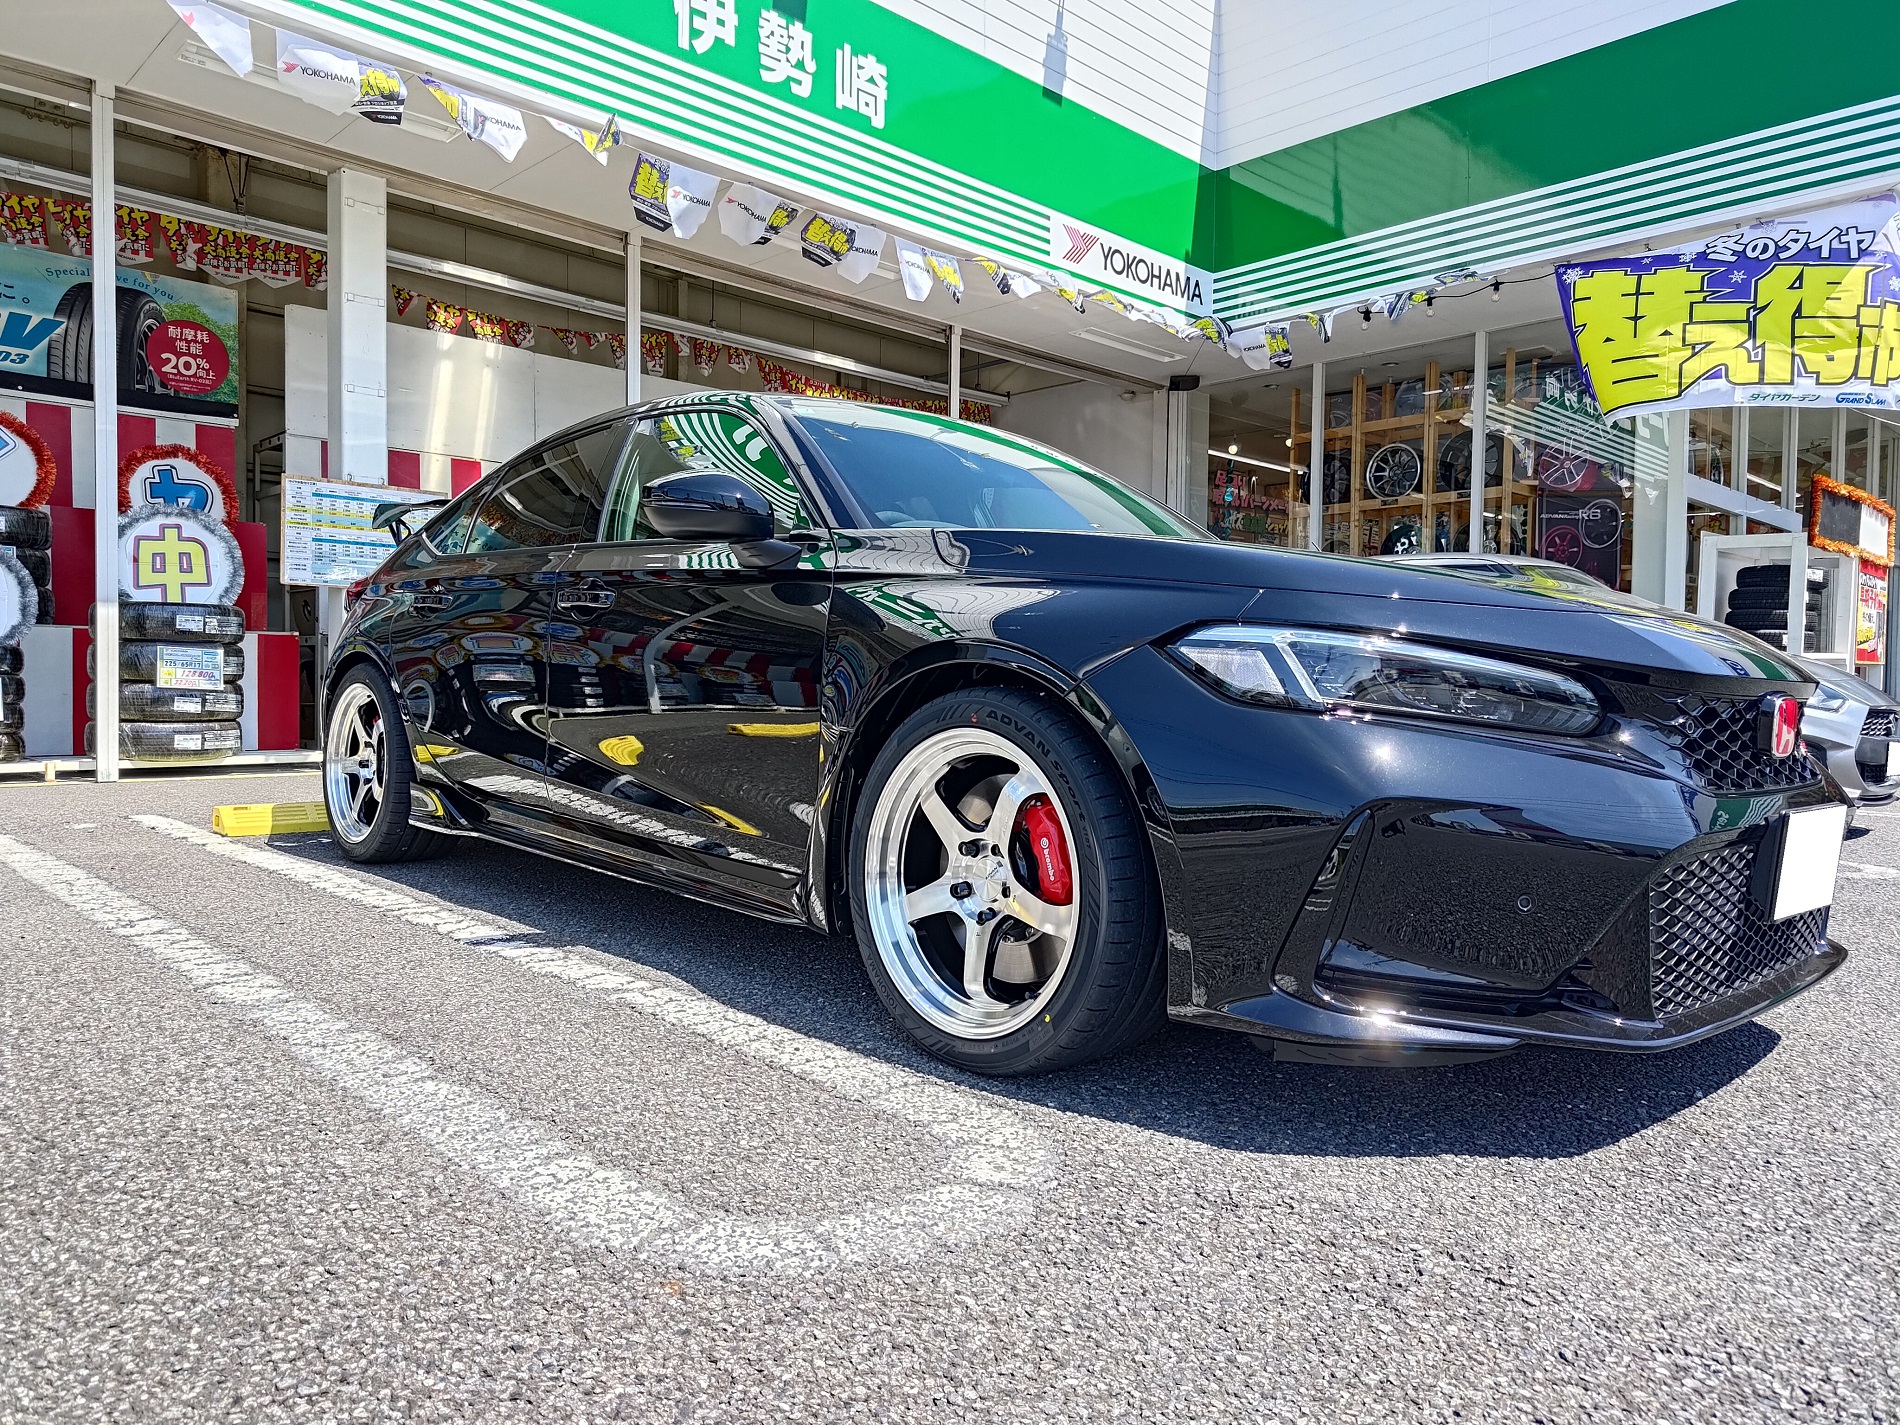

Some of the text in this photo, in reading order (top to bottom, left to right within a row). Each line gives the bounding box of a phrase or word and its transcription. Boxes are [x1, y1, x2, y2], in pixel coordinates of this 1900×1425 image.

[300, 65, 356, 86] YOKOHAMA
[673, 0, 888, 129] 伊勢崎
[682, 193, 711, 207] YOKOHAMA
[736, 201, 767, 223] YOKOHAMA
[1705, 225, 1876, 263] 冬のタイヤ
[45, 268, 90, 279] Special
[133, 278, 150, 291] for
[153, 287, 173, 300] you
[1100, 243, 1203, 306] YOKOHAMA
[167, 325, 209, 344] 耐摩耗
[175, 340, 203, 355] 性能
[160, 352, 216, 380] 20% 向上
[1748, 393, 1821, 402] タイヤガーデン
[1835, 392, 1865, 404] GRAND
[1578, 509, 1601, 520] R6
[133, 523, 212, 602] 中
[985, 709, 1052, 759] ADVAN
[1050, 759, 1087, 823] Sport
[1043, 848, 1055, 882] brembo
[866, 951, 899, 1011] YOKOHAMA
